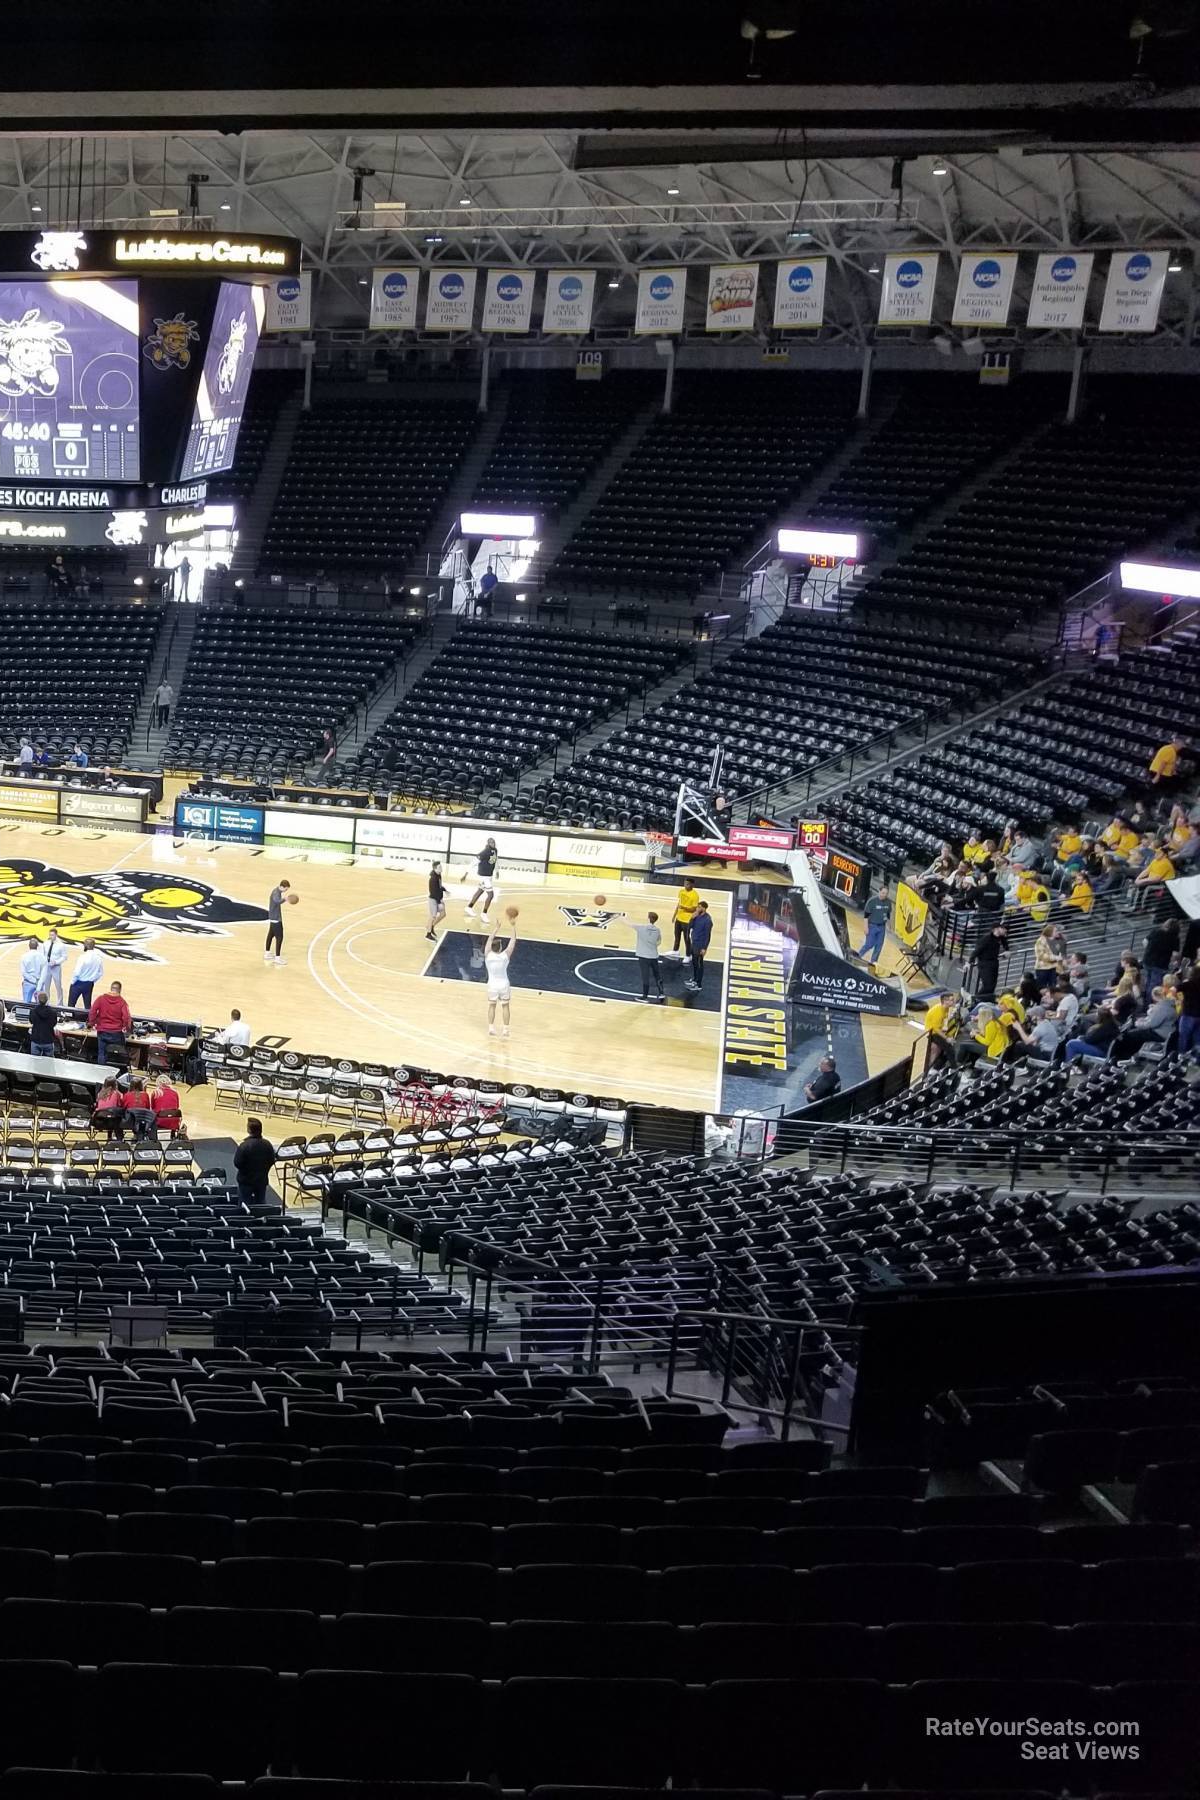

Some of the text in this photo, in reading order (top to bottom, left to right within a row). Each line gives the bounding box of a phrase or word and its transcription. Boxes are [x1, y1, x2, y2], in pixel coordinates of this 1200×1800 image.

[1052, 268, 1076, 277] NCAA
[1127, 265, 1150, 276] NCAA
[899, 273, 922, 282] NCAA
[975, 273, 999, 282] NCAA
[723, 278, 751, 289] FINAL
[791, 278, 812, 287] NCAA
[384, 284, 407, 293] NCAA
[441, 286, 463, 294] NCAA
[499, 287, 521, 295] NCAA
[561, 288, 582, 296] NCAA
[652, 286, 673, 295] NCAA
[1036, 284, 1085, 293] Indianapolis
[711, 287, 750, 300] FOUR
[1042, 295, 1076, 303] Regional
[1116, 298, 1148, 306] Regional
[895, 308, 916, 317] 2015
[970, 309, 991, 318] 2016
[440, 315, 459, 323] 1987
[1043, 313, 1067, 322] 2017
[1117, 314, 1140, 324] 2018
[577, 352, 602, 365] 109
[984, 353, 1010, 368] 111
[2, 422, 50, 441] 45:40
[65, 442, 77, 460] 0
[16, 489, 54, 506] KOCH
[57, 488, 110, 507] ARENA
[161, 487, 198, 504] CHARLES
[81, 799, 137, 813] EQUITY BANK
[802, 823, 824, 833] 45:40
[392, 832, 443, 843] HUTTON
[805, 833, 820, 844] 00
[570, 843, 601, 856] FOLEY
[802, 973, 842, 987] KANSAS
[859, 982, 887, 995] STAR
[725, 933, 788, 1071] ICHITA STATE
[858, 1002, 880, 1011] EXPECTED.
